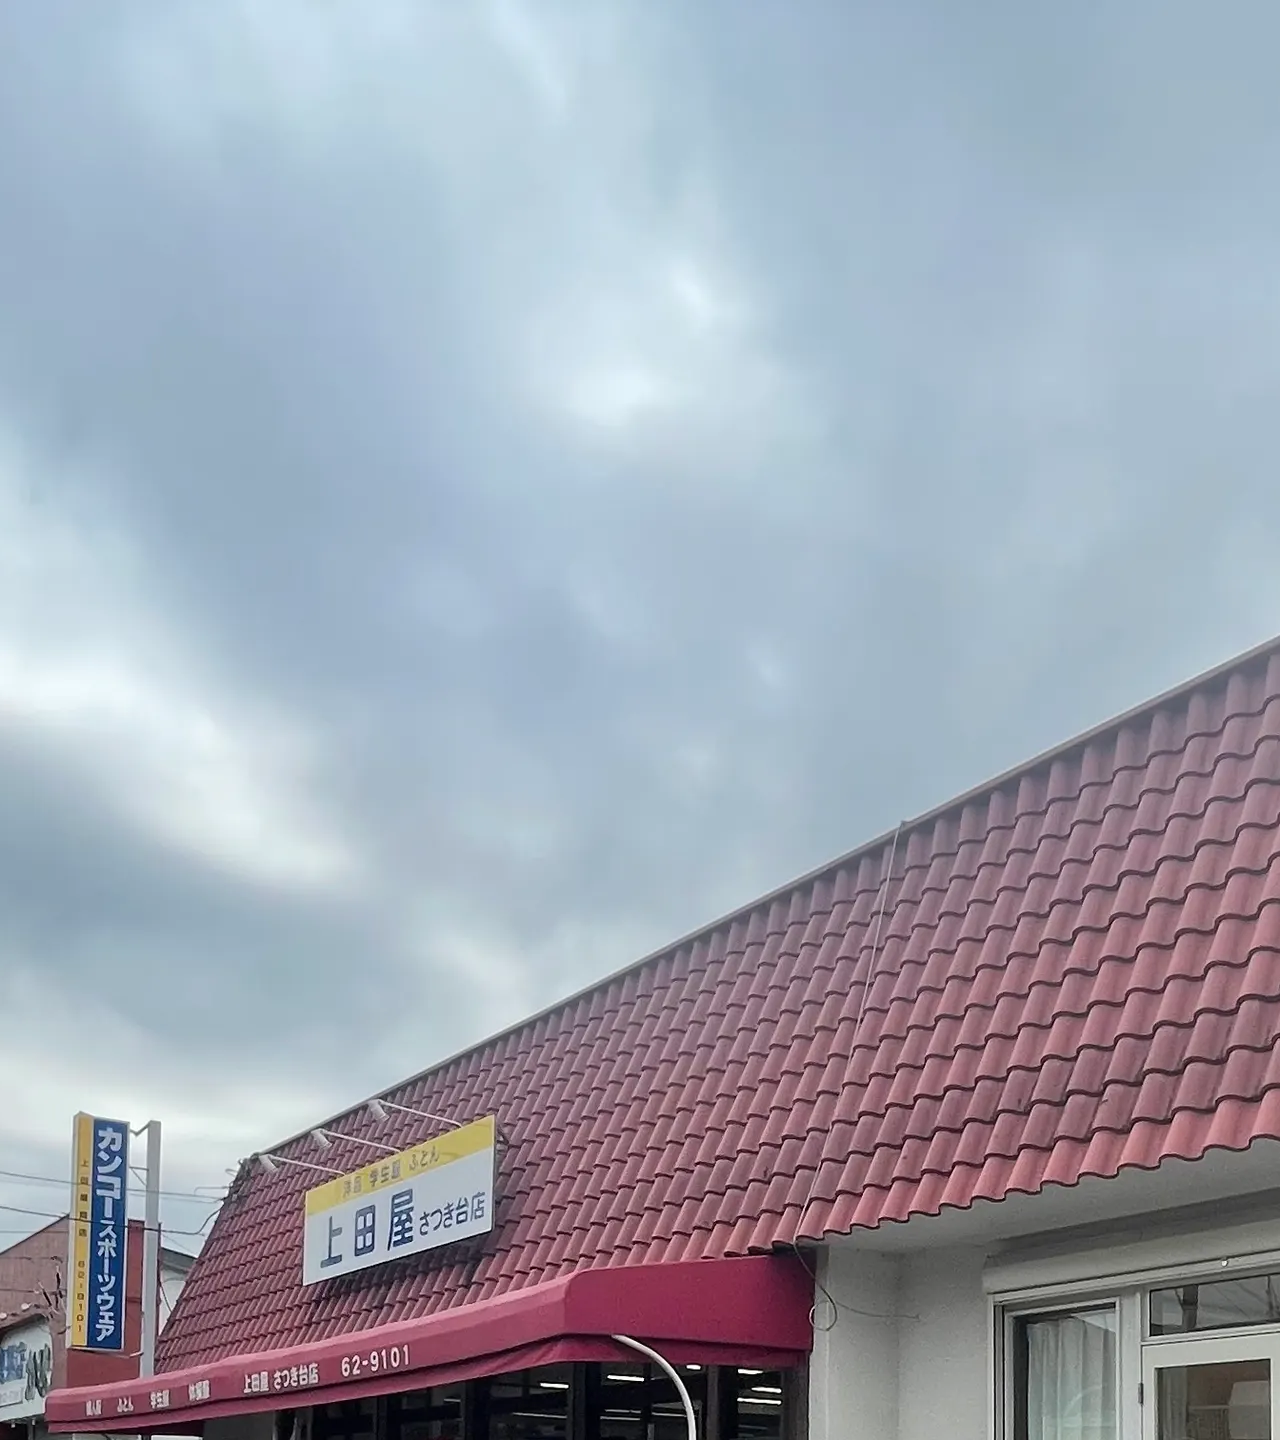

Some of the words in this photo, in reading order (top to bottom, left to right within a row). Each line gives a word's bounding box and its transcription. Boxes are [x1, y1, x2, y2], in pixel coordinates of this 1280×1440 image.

[320, 1188, 414, 1269] 上田屋
[419, 1192, 486, 1236] さつき台店
[243, 1371, 269, 1393] 上田屋
[273, 1362, 319, 1391] さつき台店
[341, 1344, 410, 1377] 62-9101
